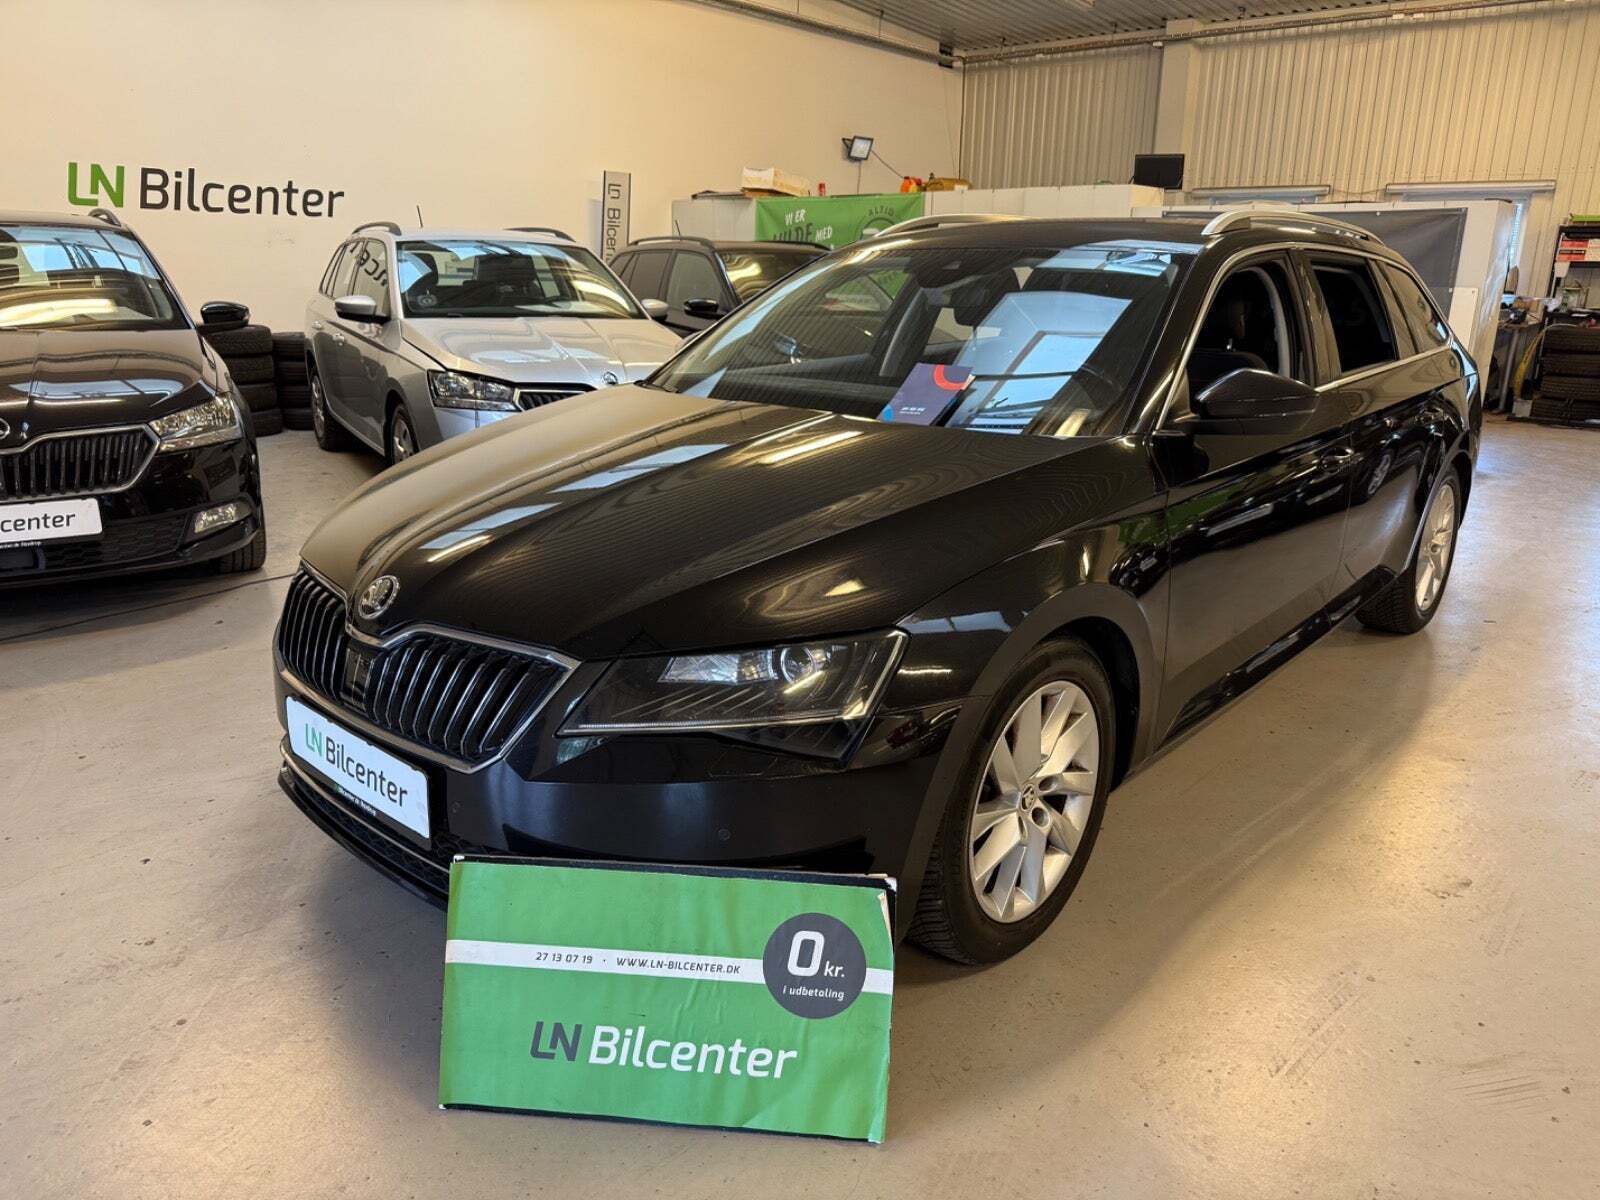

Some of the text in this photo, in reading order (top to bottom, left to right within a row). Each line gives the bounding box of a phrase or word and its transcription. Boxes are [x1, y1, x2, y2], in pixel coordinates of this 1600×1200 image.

[67, 161, 345, 218] LN Bilcenter
[795, 208, 806, 223] ER
[815, 225, 833, 242] MED
[305, 723, 323, 757] LN
[326, 735, 408, 808] Bilcenter
[535, 951, 741, 975] 27 13 07 19 WWW.LN-BILCENTER.DK
[787, 930, 845, 978] 0 kr.
[789, 986, 845, 1002] udbetaling
[529, 1020, 798, 1079] LN Bilcenter
